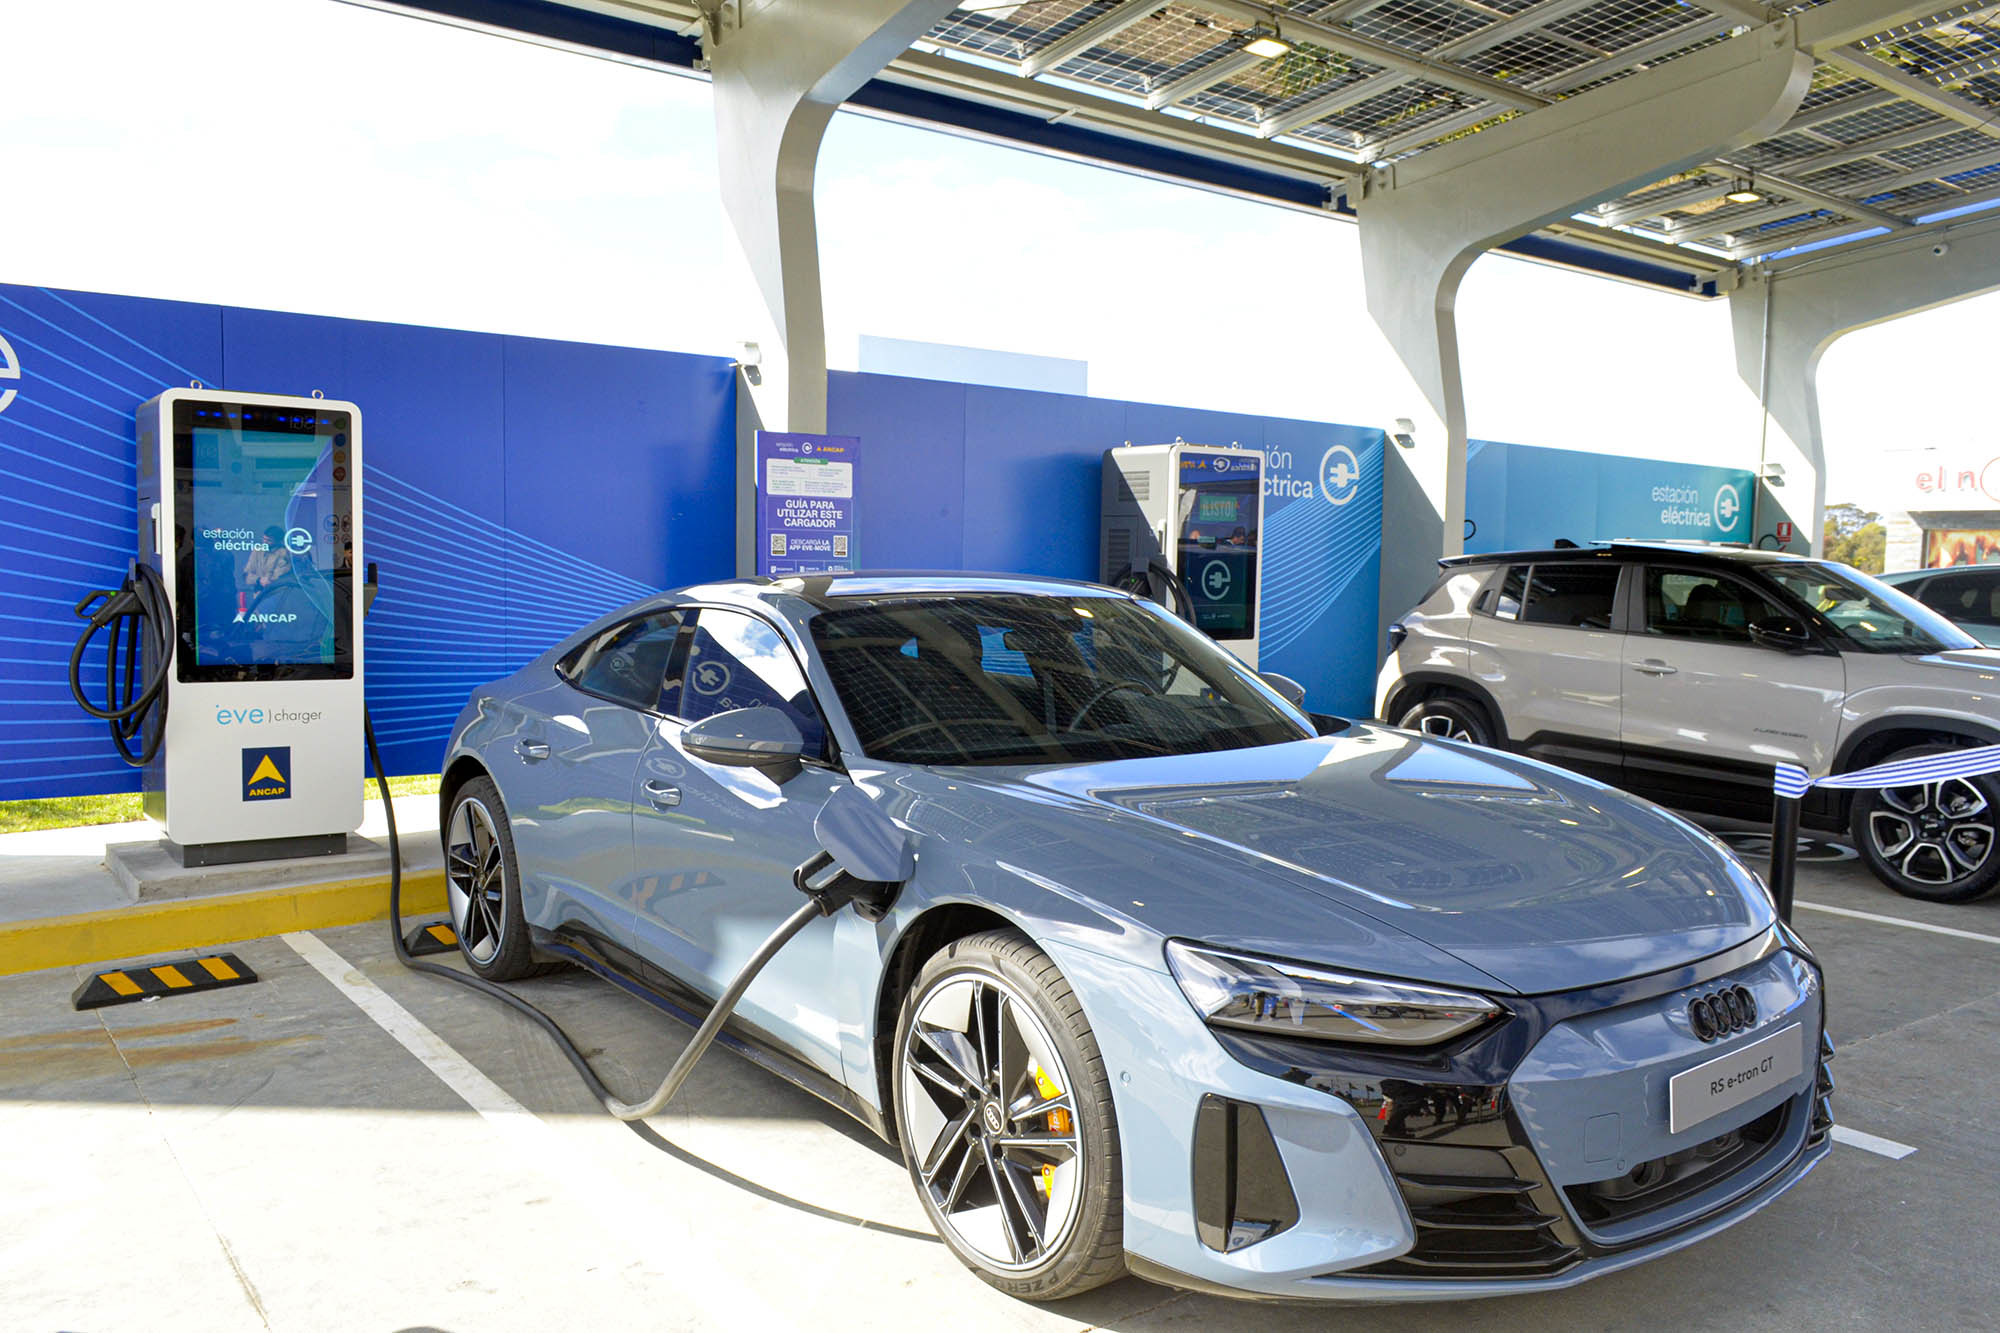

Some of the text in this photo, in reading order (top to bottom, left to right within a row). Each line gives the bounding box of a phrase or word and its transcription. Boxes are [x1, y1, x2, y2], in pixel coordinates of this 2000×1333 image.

[1264, 474, 1313, 499] ctrica
[1651, 485, 1699, 505] estación
[785, 498, 834, 510] GUÍA PARA
[777, 509, 843, 519] UTILIZAR ESTE
[1661, 506, 1711, 527] eléctrica
[784, 518, 836, 528] CARGADOR
[203, 528, 254, 539] estación
[214, 540, 270, 552] eléctrica
[248, 614, 297, 623] ANCAP
[216, 705, 322, 725] eve charger
[249, 787, 286, 797] ANCAP
[1710, 1056, 1774, 1096] RS e-tron GT
